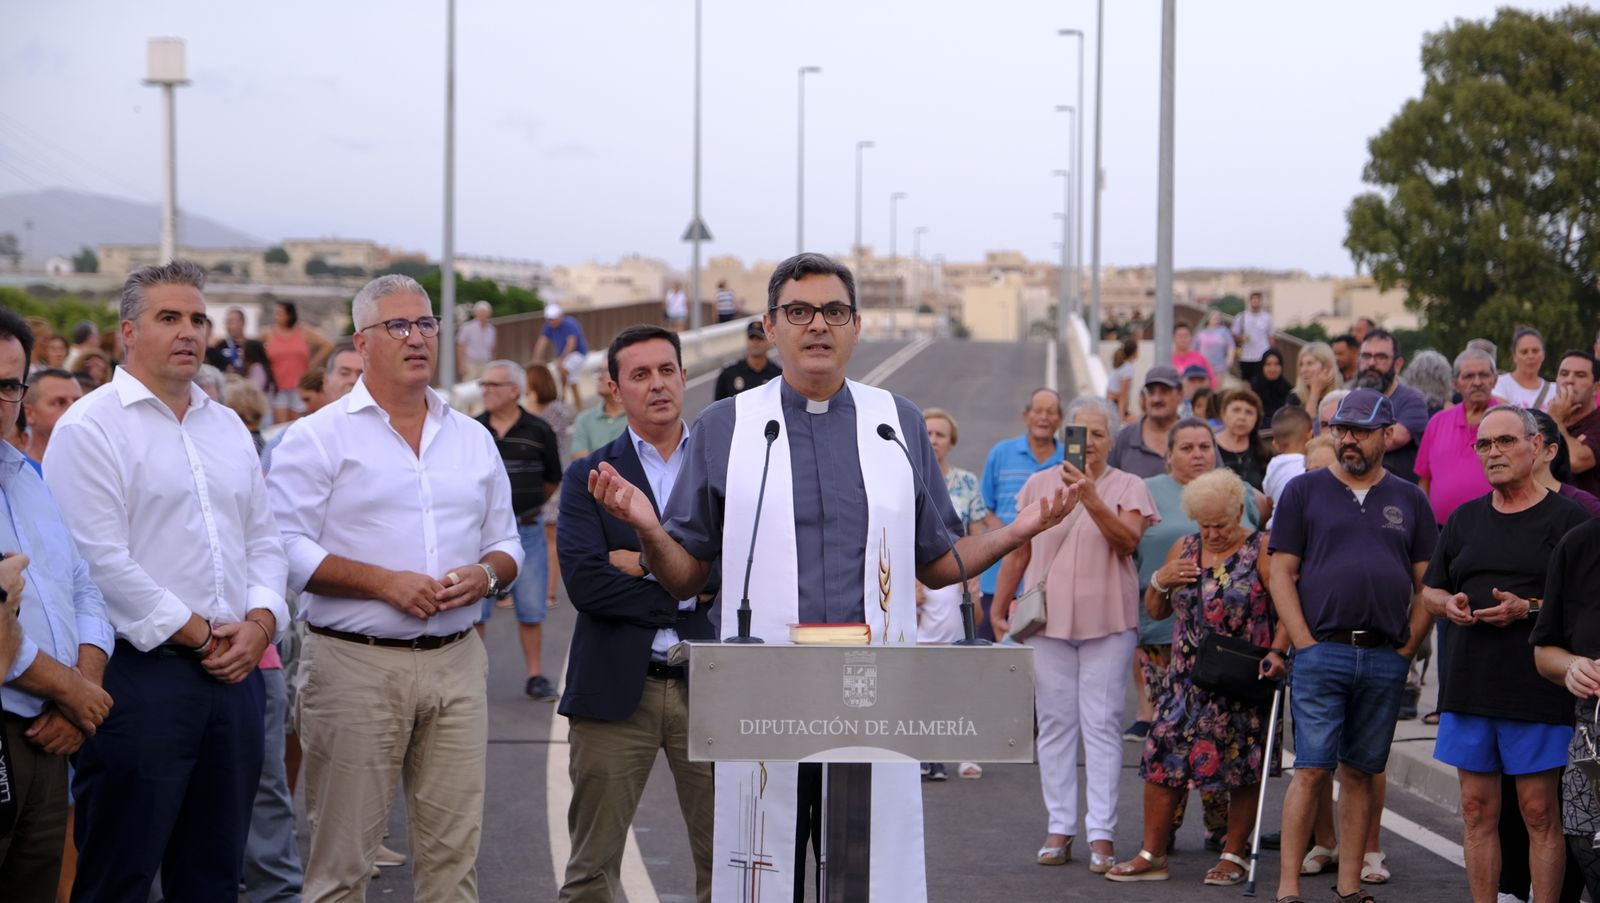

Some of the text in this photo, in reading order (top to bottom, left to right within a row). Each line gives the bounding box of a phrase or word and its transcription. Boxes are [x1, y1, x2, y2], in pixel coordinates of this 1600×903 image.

[739, 715, 978, 736] DIPUTACIÓN DE ALMERÍA
